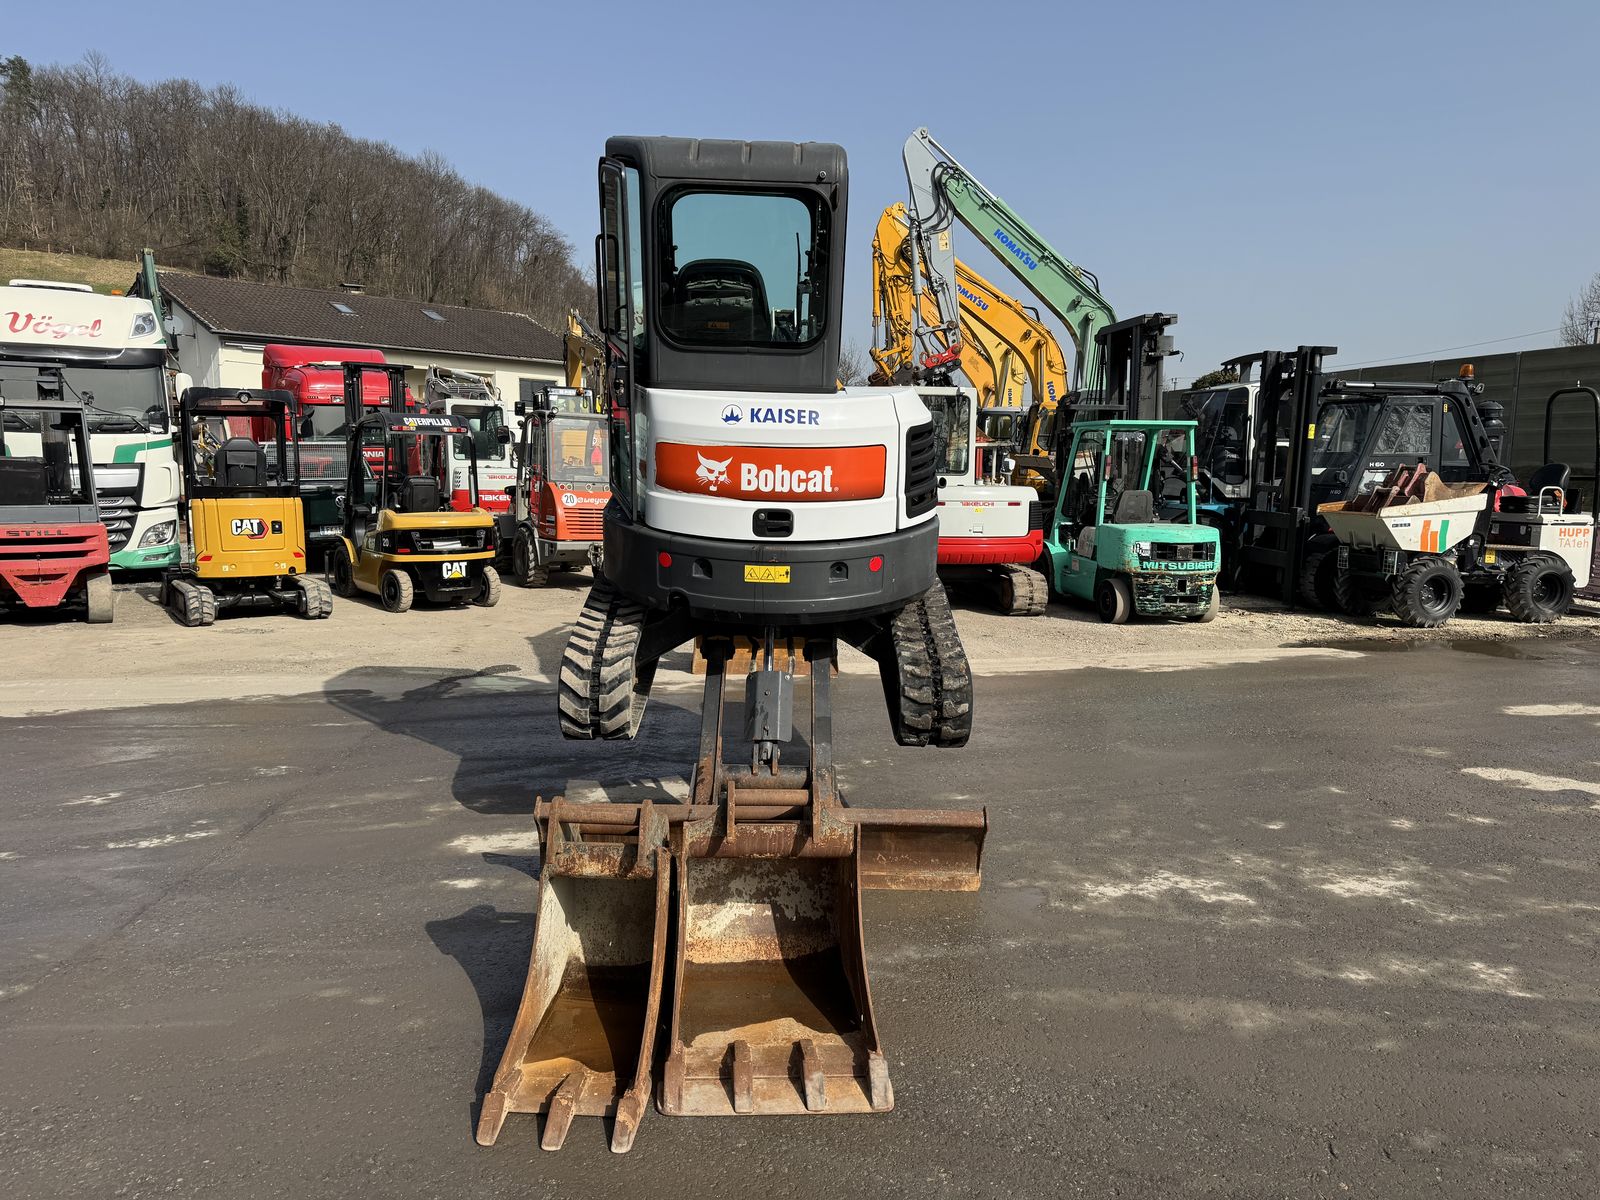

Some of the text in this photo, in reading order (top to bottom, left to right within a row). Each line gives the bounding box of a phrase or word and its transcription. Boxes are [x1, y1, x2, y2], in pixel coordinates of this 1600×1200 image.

[993, 228, 1037, 271] KOMATSU
[957, 284, 989, 311] OMATSU
[5, 311, 102, 339] Vögel
[403, 417, 453, 427] CATERPILLAR
[749, 407, 820, 426] KAISER
[740, 462, 833, 493] Bobcat
[564, 494, 575, 504] 20
[6, 529, 69, 537] STILL
[231, 518, 261, 536] CAT
[1559, 527, 1590, 537] HUPP
[442, 562, 467, 579] CAT
